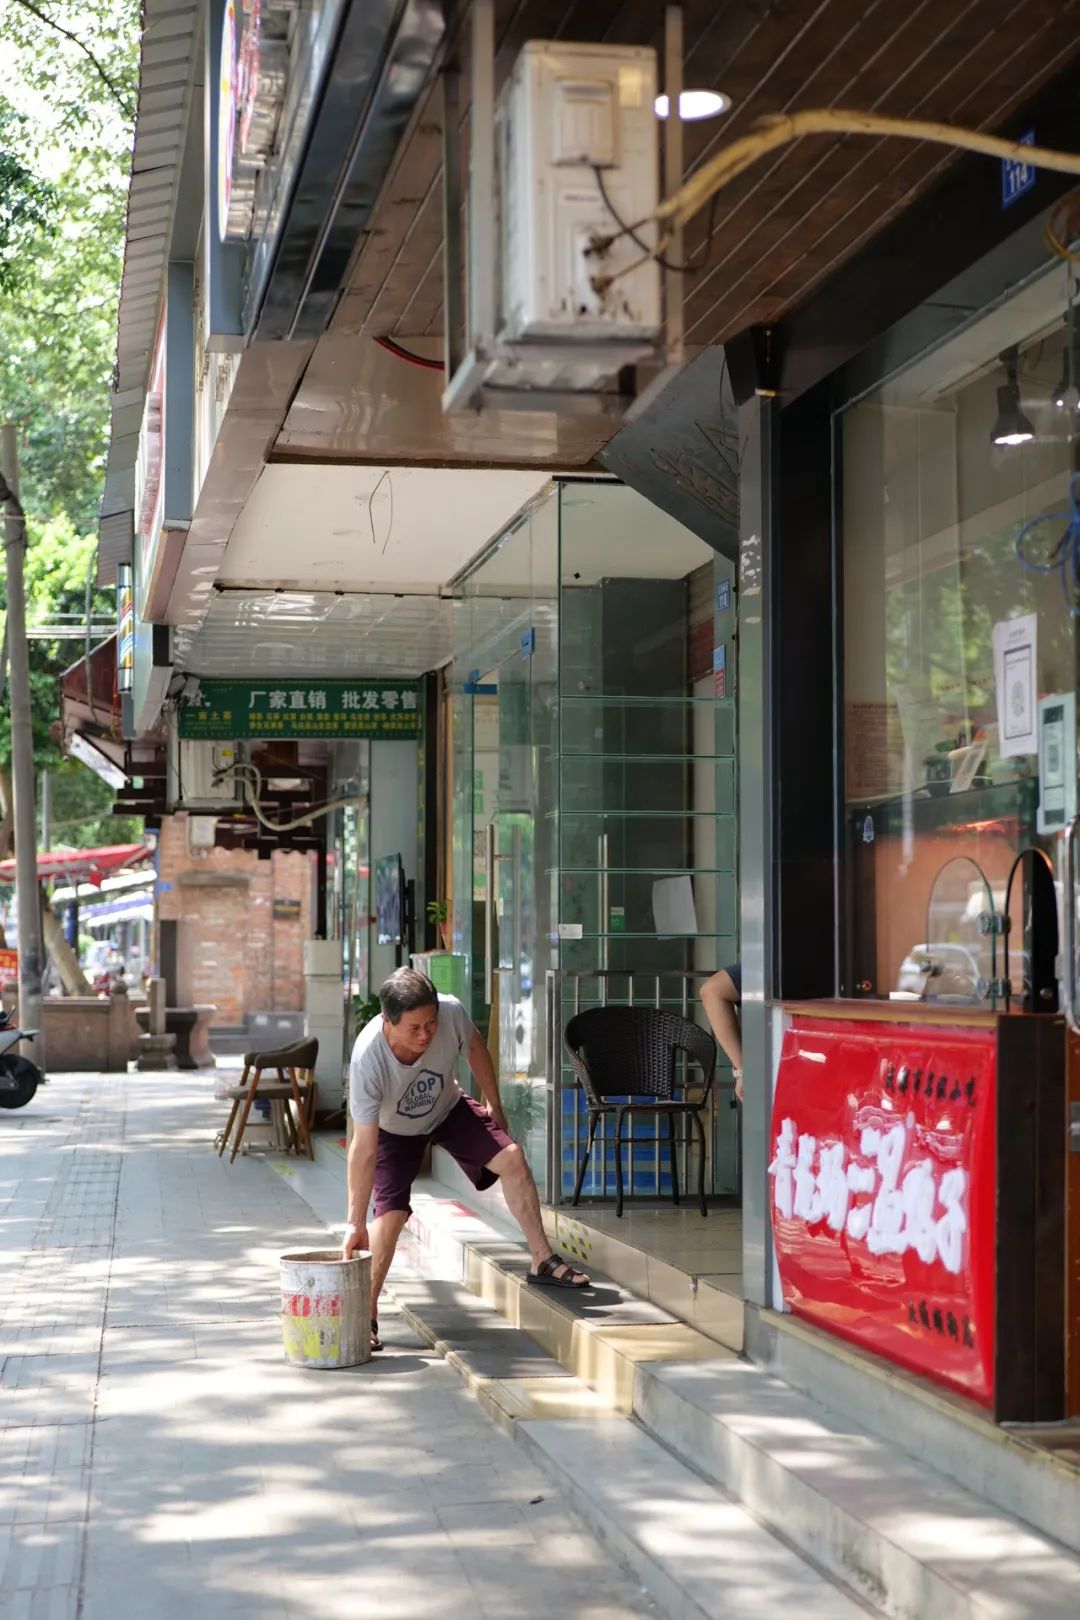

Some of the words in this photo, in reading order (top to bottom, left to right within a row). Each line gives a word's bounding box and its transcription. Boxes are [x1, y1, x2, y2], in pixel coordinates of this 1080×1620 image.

[249, 690, 327, 709] 厂家直销
[341, 690, 417, 709] 批发零售
[404, 1096, 435, 1112] WARMING
[406, 1091, 432, 1105] GLOBAL
